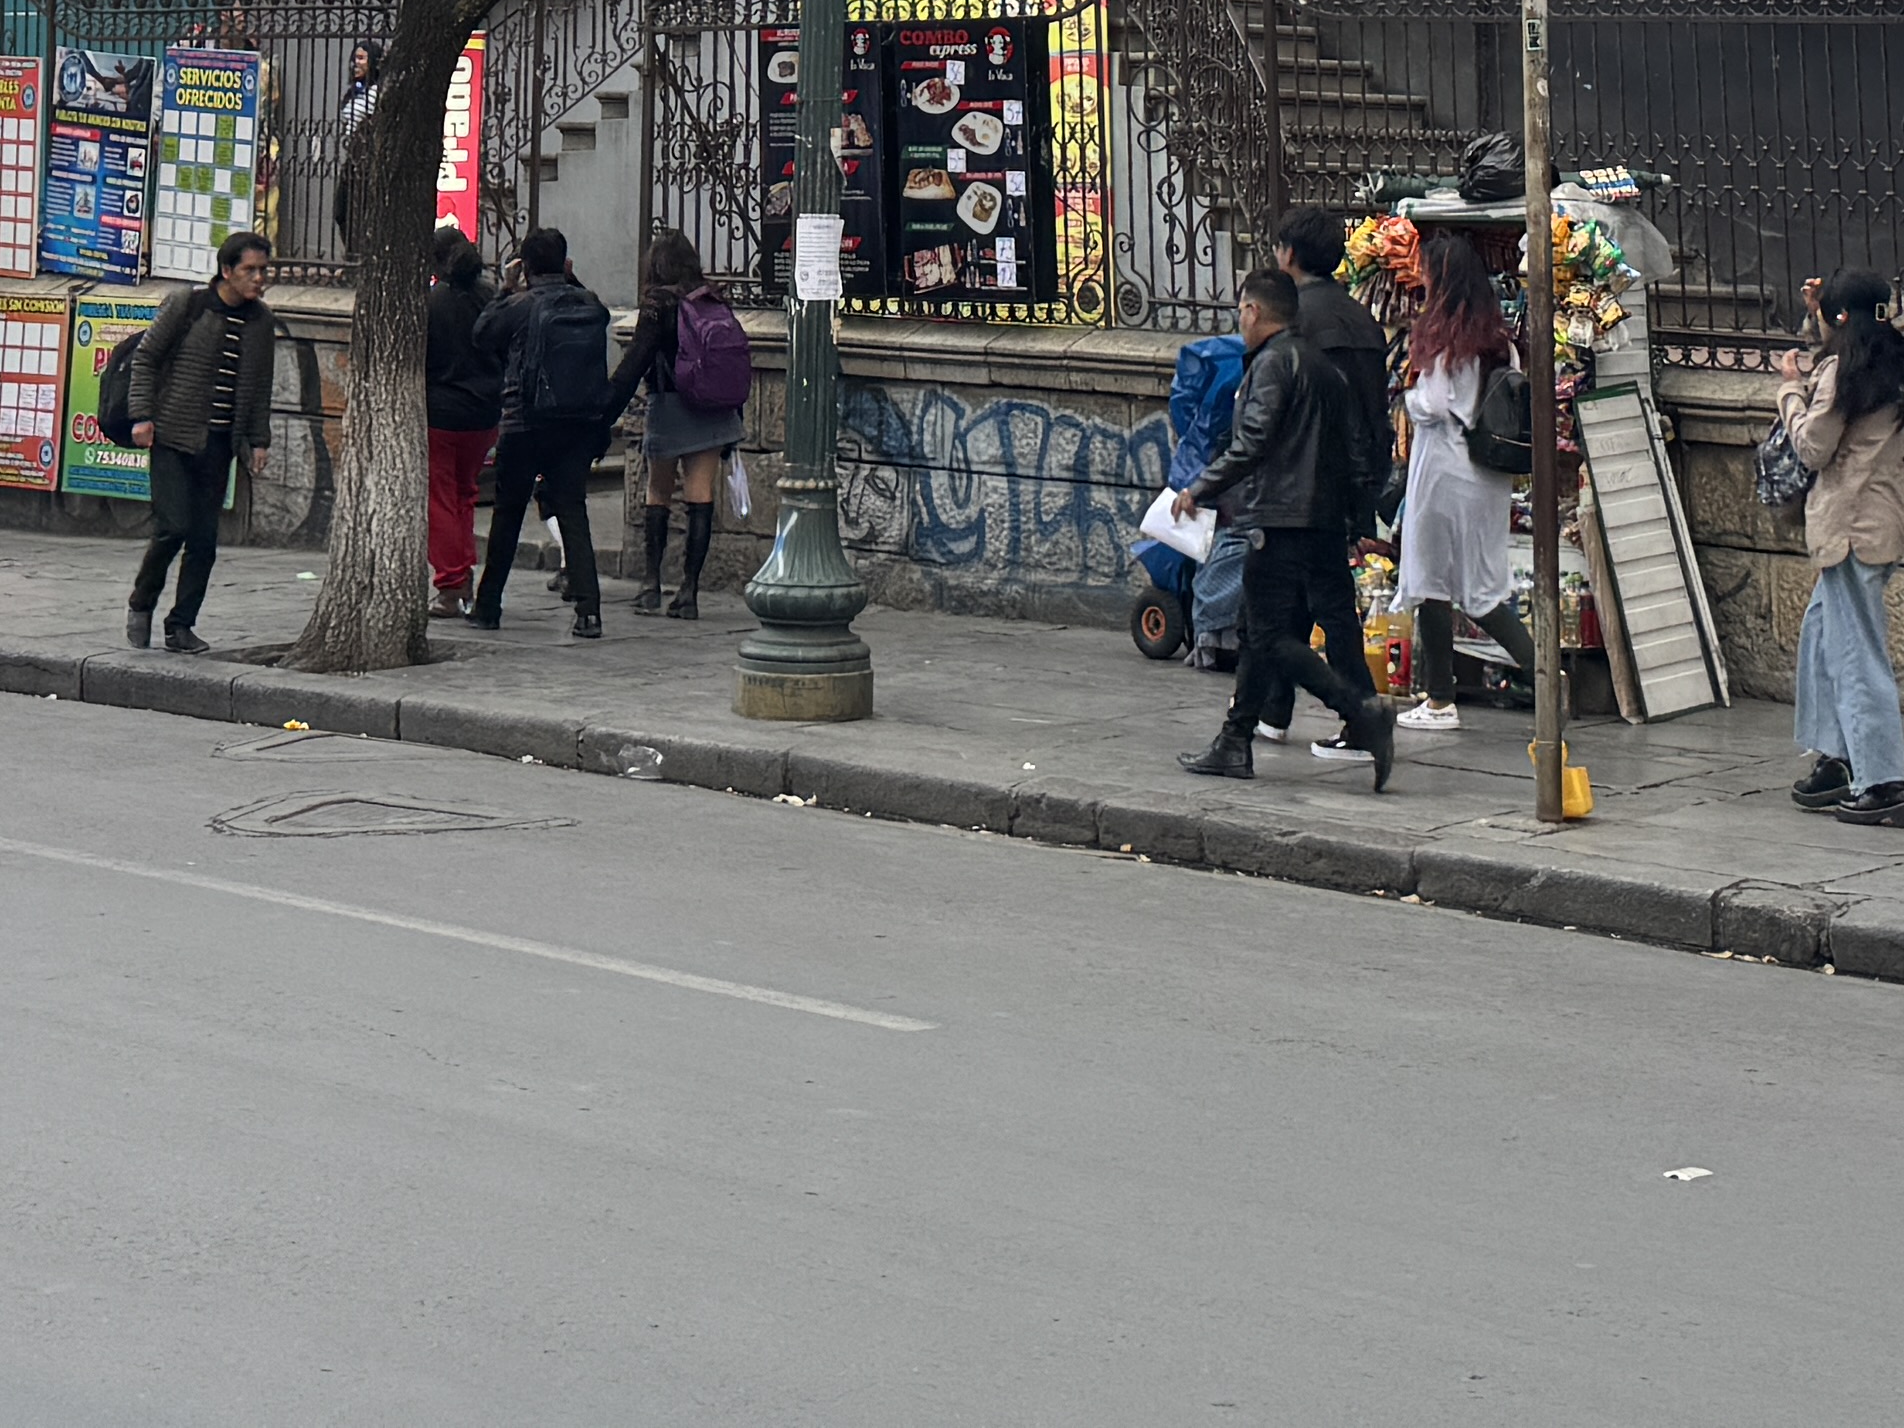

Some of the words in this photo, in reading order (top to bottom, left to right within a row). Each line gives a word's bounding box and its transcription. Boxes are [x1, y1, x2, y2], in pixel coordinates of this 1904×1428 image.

[900, 30, 969, 45] COMBO
[179, 67, 242, 89] SERVICIOS
[176, 88, 243, 111] OFRECIDOS
